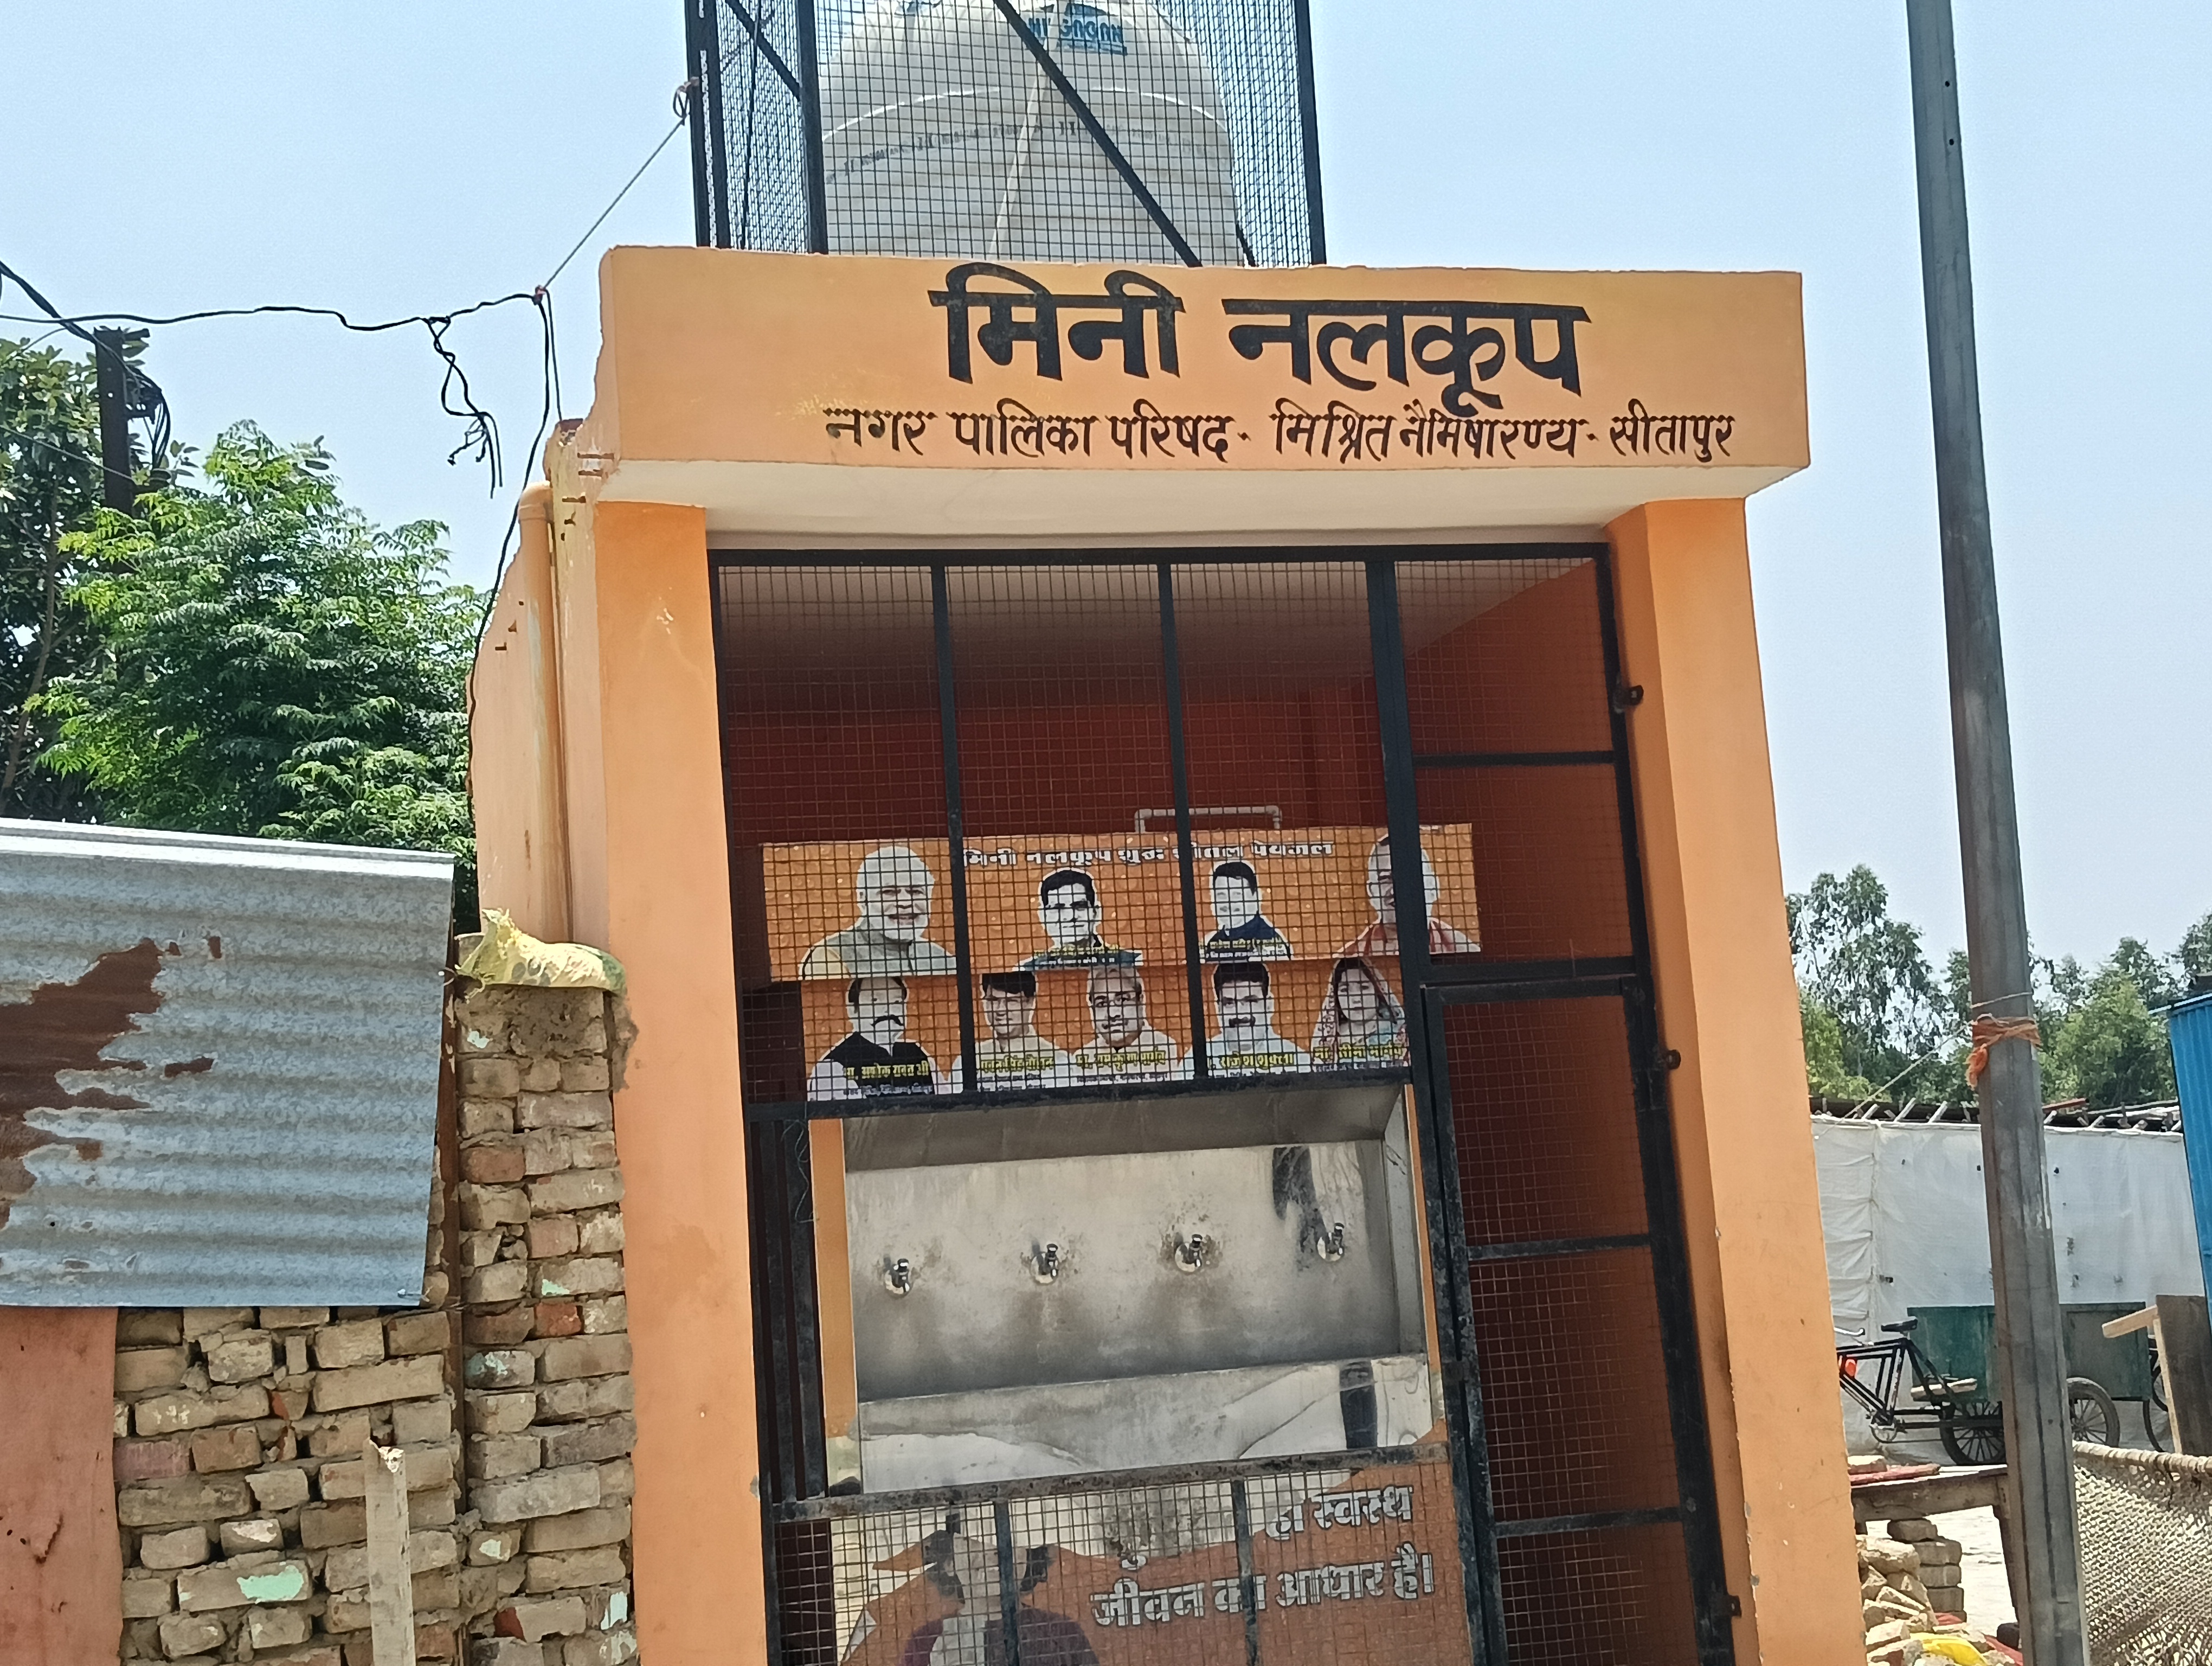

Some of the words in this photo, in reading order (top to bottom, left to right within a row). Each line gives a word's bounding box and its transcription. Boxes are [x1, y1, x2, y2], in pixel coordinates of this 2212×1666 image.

[928, 262, 1186, 384] मिनी
[1221, 298, 1592, 417] नलकूप
[823, 408, 936, 455] नगर
[947, 398, 1099, 457] पालिका
[1269, 398, 1396, 464] मिश्रित
[1610, 399, 1735, 463] सीतापुर
[963, 848, 1017, 867] मिनी
[1026, 849, 1113, 867] नलकूप
[1251, 840, 1335, 858] पेयजल
[1089, 1577, 1205, 1627] जीवन
[1211, 1574, 1268, 1614] का
[1275, 1560, 1385, 1609] आधार
